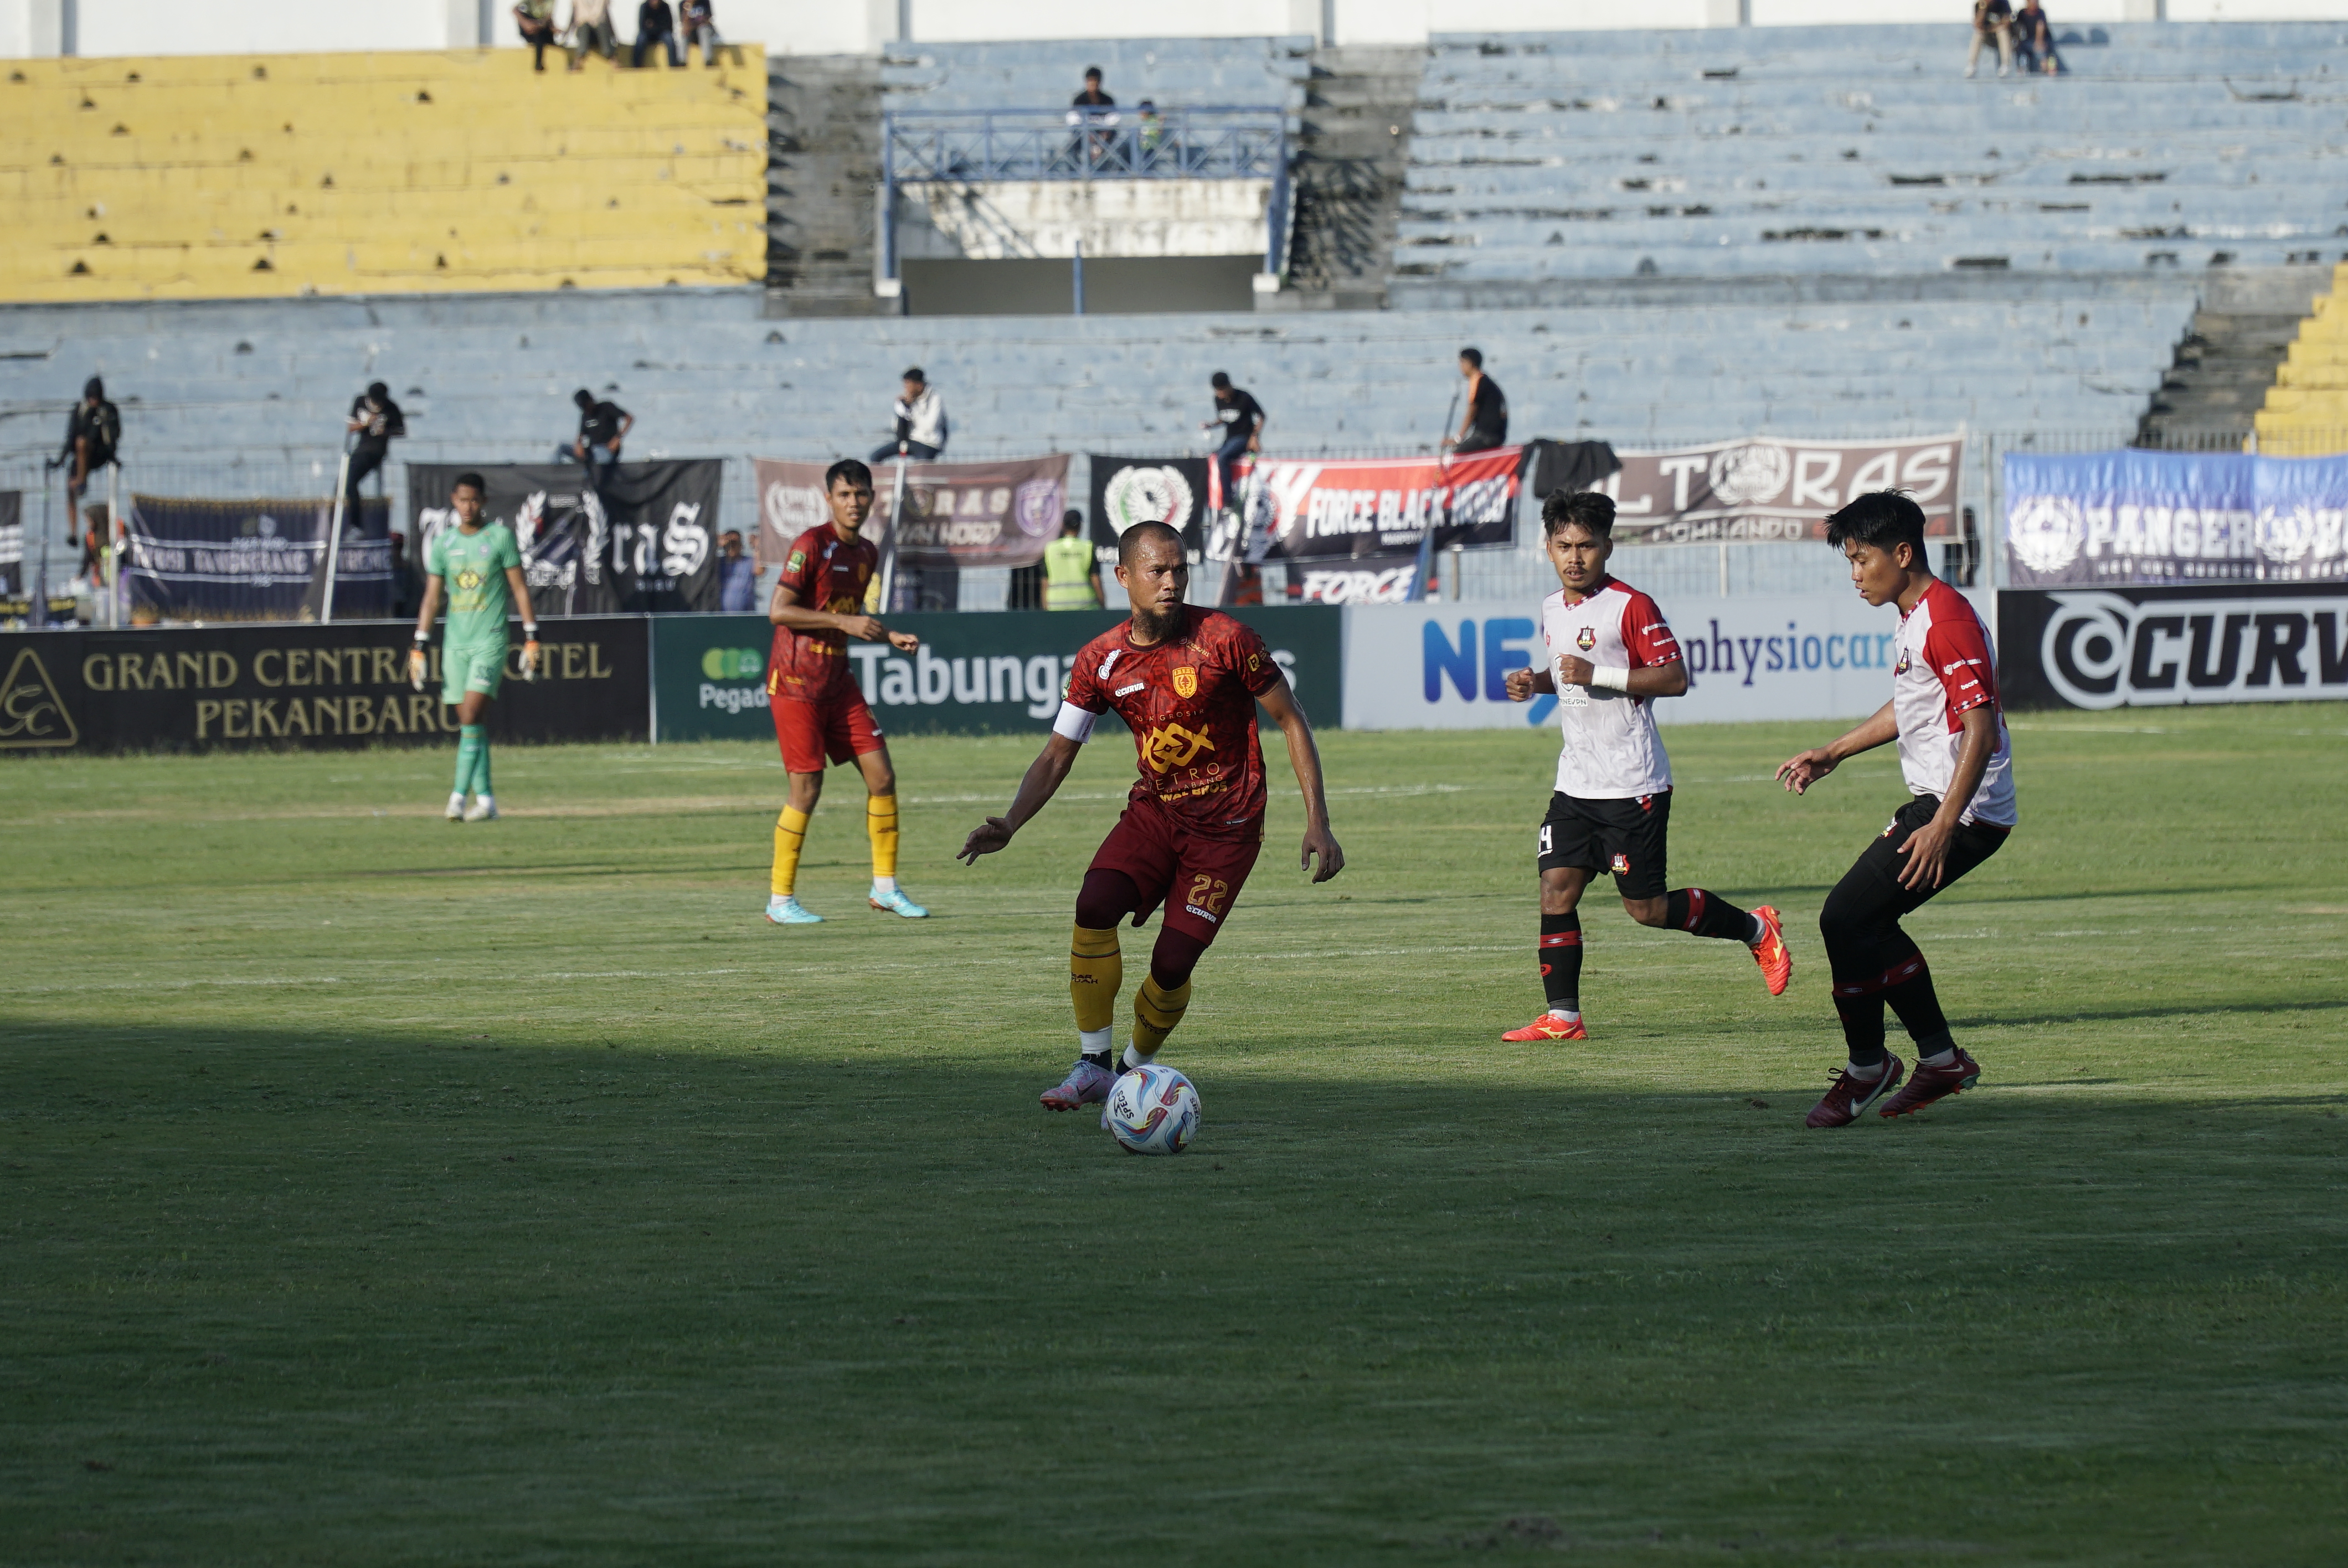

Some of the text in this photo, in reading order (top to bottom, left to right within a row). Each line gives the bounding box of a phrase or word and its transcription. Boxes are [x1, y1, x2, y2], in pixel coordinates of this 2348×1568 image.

[1306, 487, 1377, 539] FORCE
[1377, 486, 1450, 533] BLACK
[1302, 564, 1417, 605] FORCE
[83, 650, 238, 691] GRAND
[501, 641, 612, 681] OTEL
[1684, 617, 1894, 687] physiocar
[699, 683, 771, 714] Pegad
[1119, 682, 1145, 696] CURVA
[195, 694, 461, 739] PEKANBARU
[1159, 708, 1204, 721] GROSIR
[1159, 791, 1189, 803] WAL
[1192, 781, 1228, 795] BROS
[1187, 873, 1228, 915] 22
[1191, 905, 1217, 924] CURVA
[1117, 1090, 1135, 1119] SPECS
